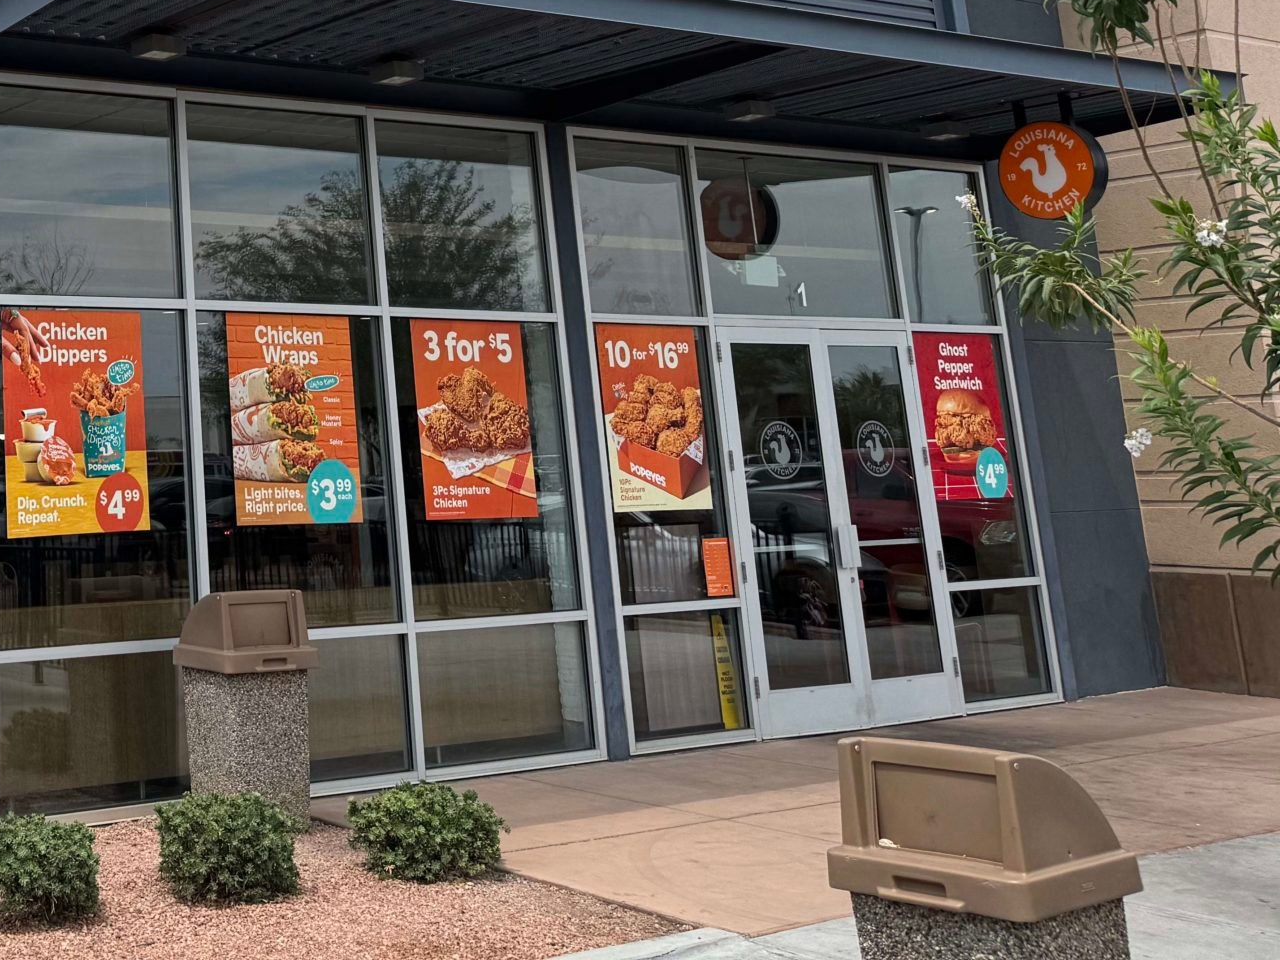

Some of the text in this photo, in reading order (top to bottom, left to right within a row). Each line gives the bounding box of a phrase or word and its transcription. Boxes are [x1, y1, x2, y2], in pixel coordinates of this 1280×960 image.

[1009, 129, 1075, 158] LOUISIANA
[1076, 162, 1088, 171] 72
[1021, 188, 1081, 212] KITCHEN
[37, 322, 108, 340] Chicken
[254, 325, 324, 345] Chicken
[423, 330, 512, 363] 3 for $5
[604, 340, 631, 368] 10
[632, 348, 647, 360] for
[938, 342, 968, 357] Ghost
[39, 345, 108, 366] Dippers
[262, 345, 319, 367] Wraps
[937, 360, 974, 376] Pepper
[934, 376, 983, 391] Sandwich
[325, 414, 342, 422] Honey
[764, 424, 794, 440] LOUISIANA
[860, 423, 889, 439] LOUISIANA
[329, 438, 344, 446] Spicy
[866, 461, 890, 473] KITCHEN
[244, 487, 304, 501] Light bites.
[432, 485, 491, 497] 3Pc Signature
[17, 494, 87, 511] Dip. Crunch.
[245, 501, 307, 515] Right price.
[433, 498, 468, 508] Chicken
[18, 510, 61, 525] Repeat.
